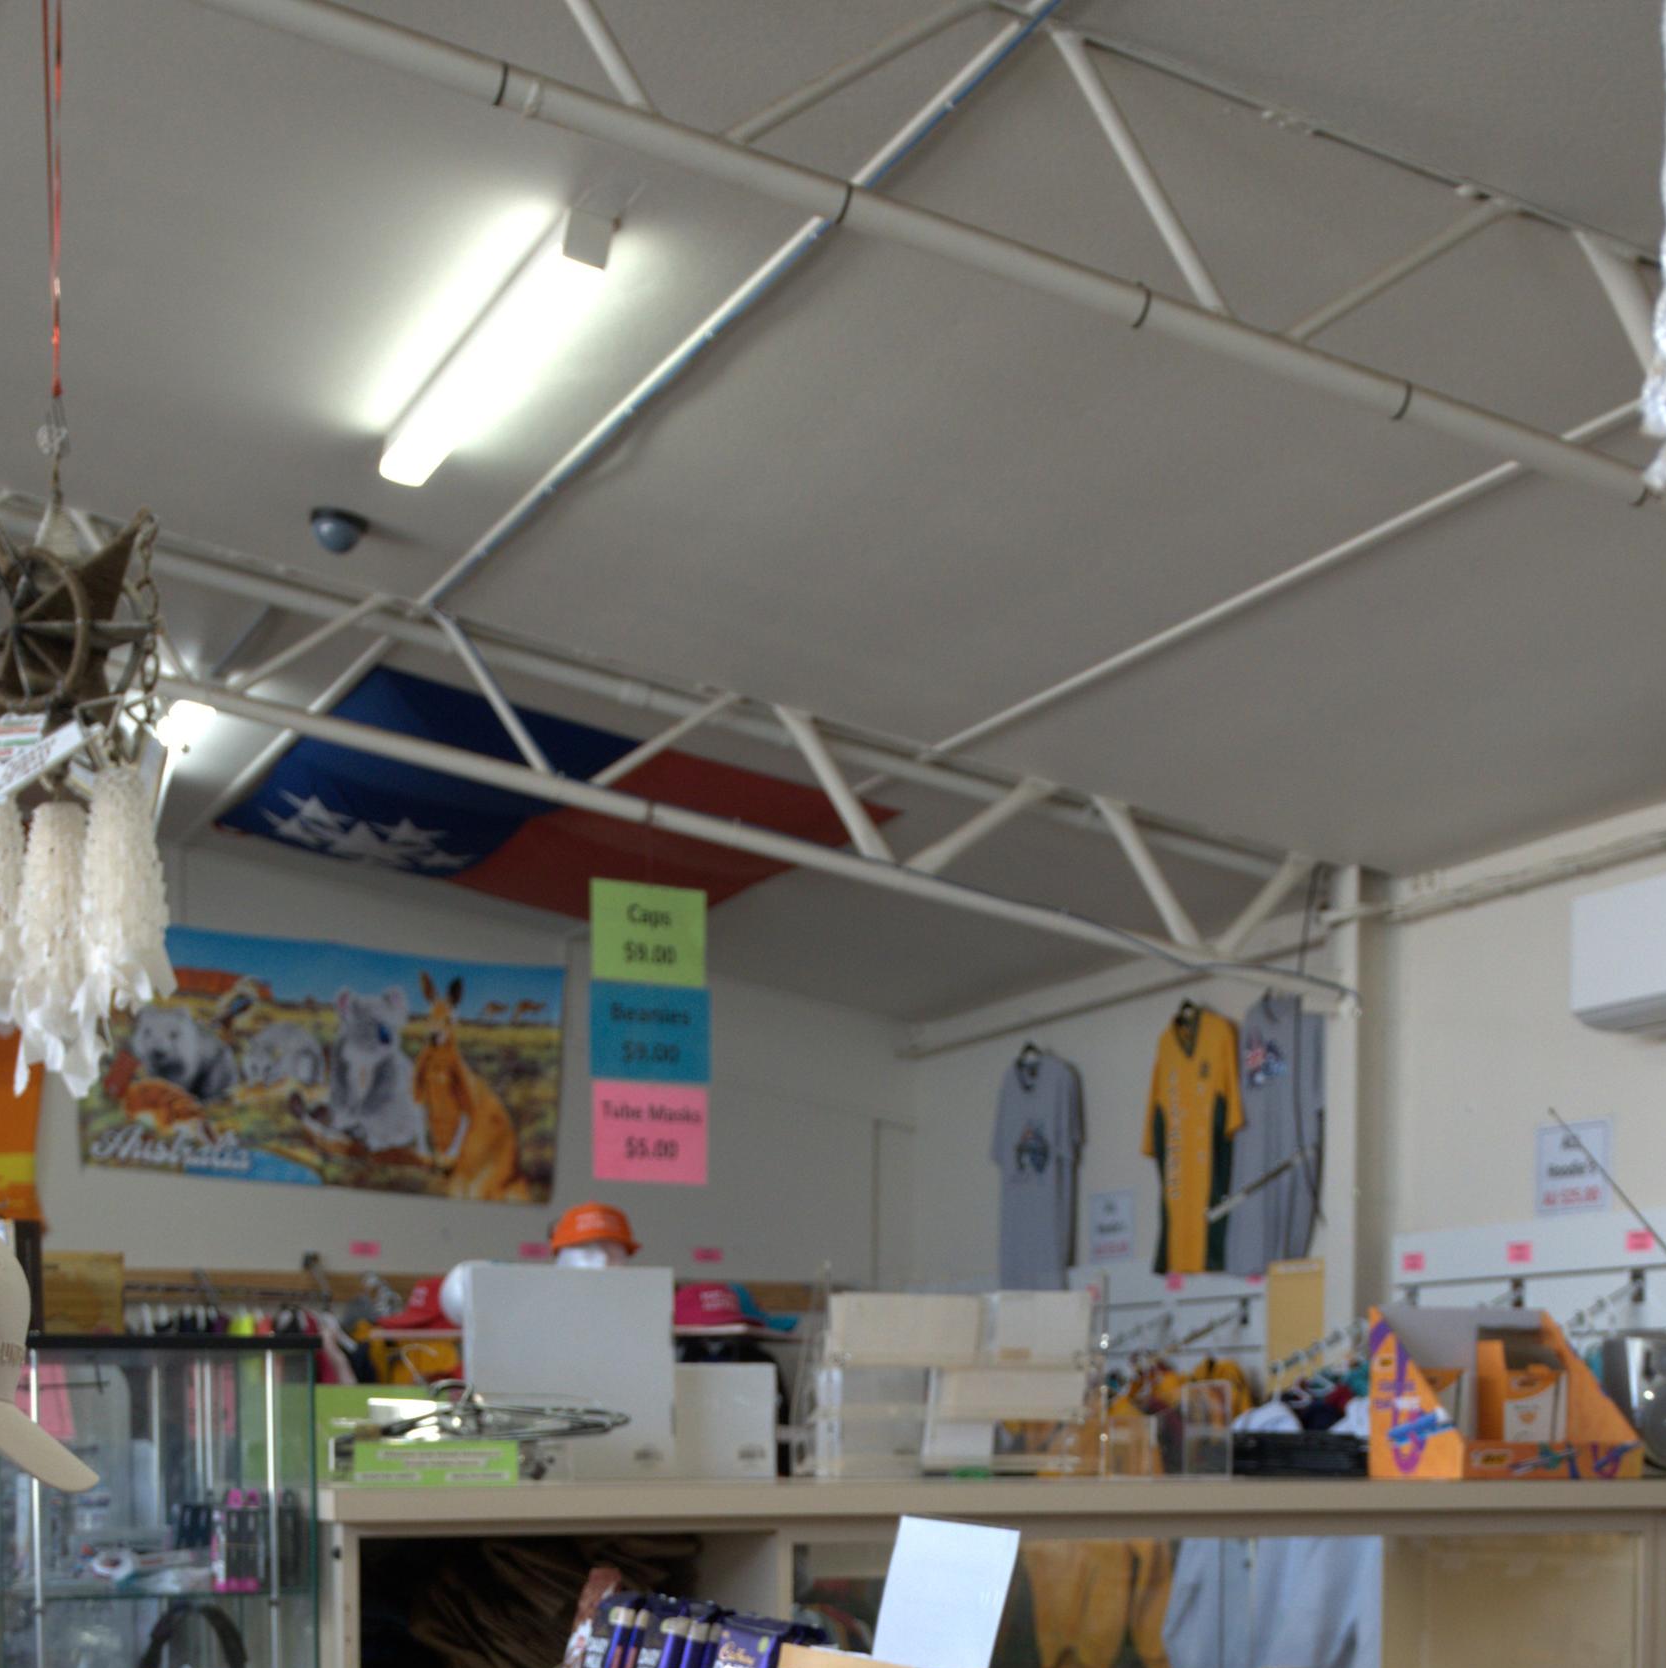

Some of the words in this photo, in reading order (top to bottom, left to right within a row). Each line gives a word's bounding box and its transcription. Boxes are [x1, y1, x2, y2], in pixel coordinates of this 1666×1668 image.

[627, 904, 672, 928] Caps
[610, 1002, 692, 1026] Beanies
[91, 1119, 250, 1170] Australia
